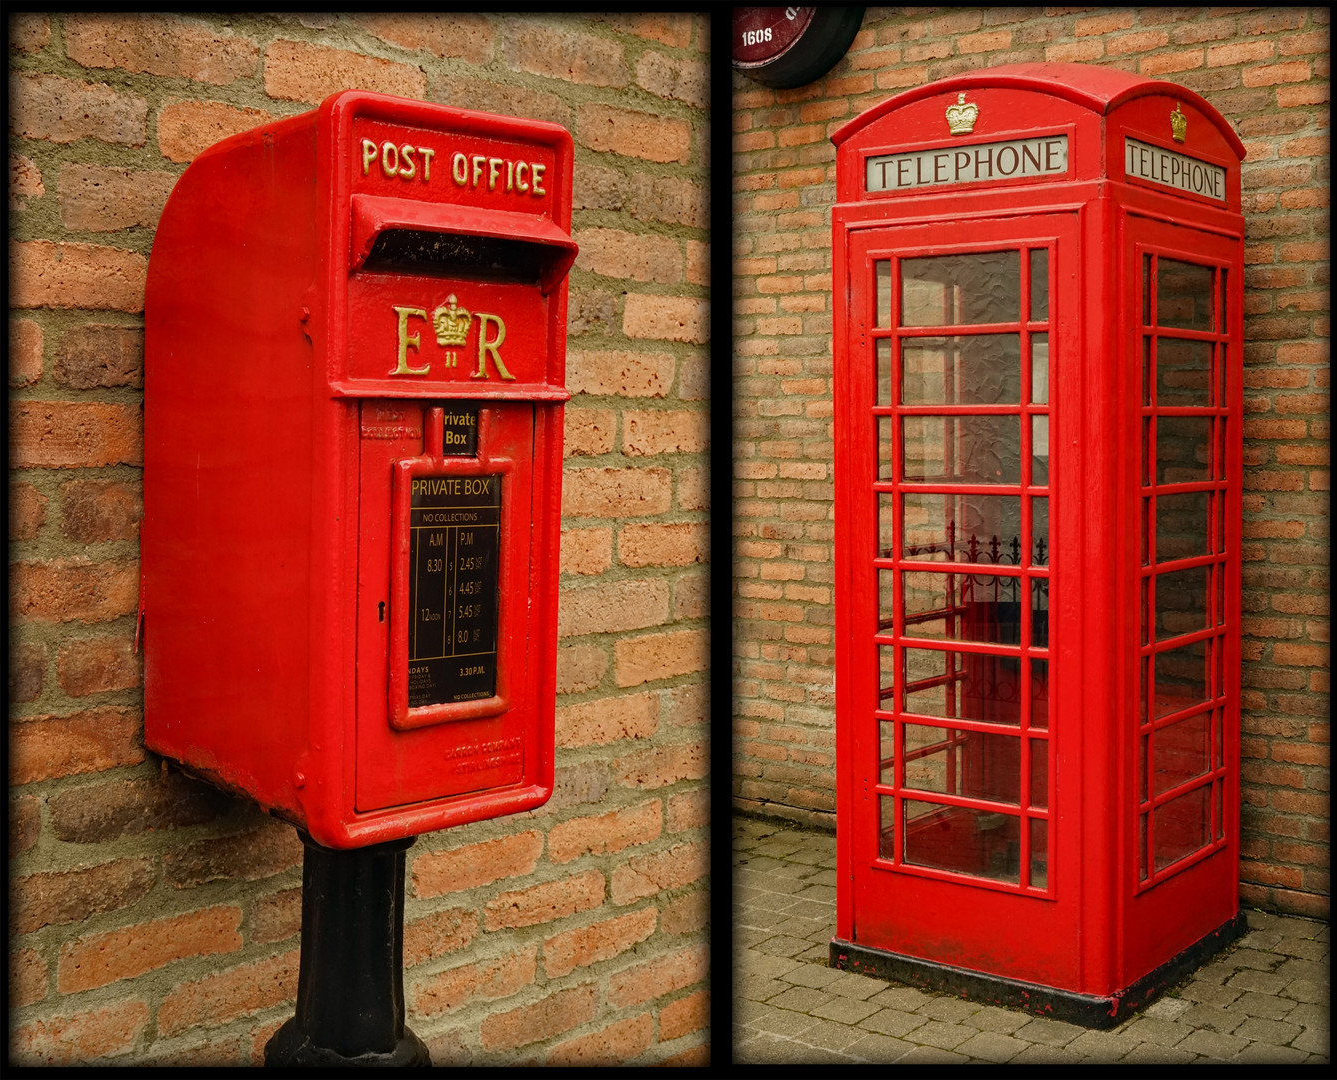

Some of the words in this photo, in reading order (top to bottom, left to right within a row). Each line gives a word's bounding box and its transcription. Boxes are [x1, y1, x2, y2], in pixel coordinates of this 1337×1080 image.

[742, 27, 773, 47] 1608
[361, 139, 435, 181] POST
[452, 153, 547, 195] OFFICE
[875, 140, 1062, 189] TELEPHONE
[1127, 143, 1222, 199] TELEPHONE
[444, 411, 477, 426] rivate
[445, 430, 467, 445] Box
[411, 479, 461, 496] PRIVATE
[464, 479, 490, 495] BOX
[422, 513, 434, 522] NO
[434, 512, 478, 522] COLLECTIONS
[427, 559, 443, 572] 8.30
[460, 557, 475, 571] 2.45
[459, 581, 474, 595] 4.45
[458, 605, 473, 619] 5.45
[458, 630, 469, 643] 8.0
[408, 666, 429, 674] NDAYS
[459, 667, 473, 677] 3.30
